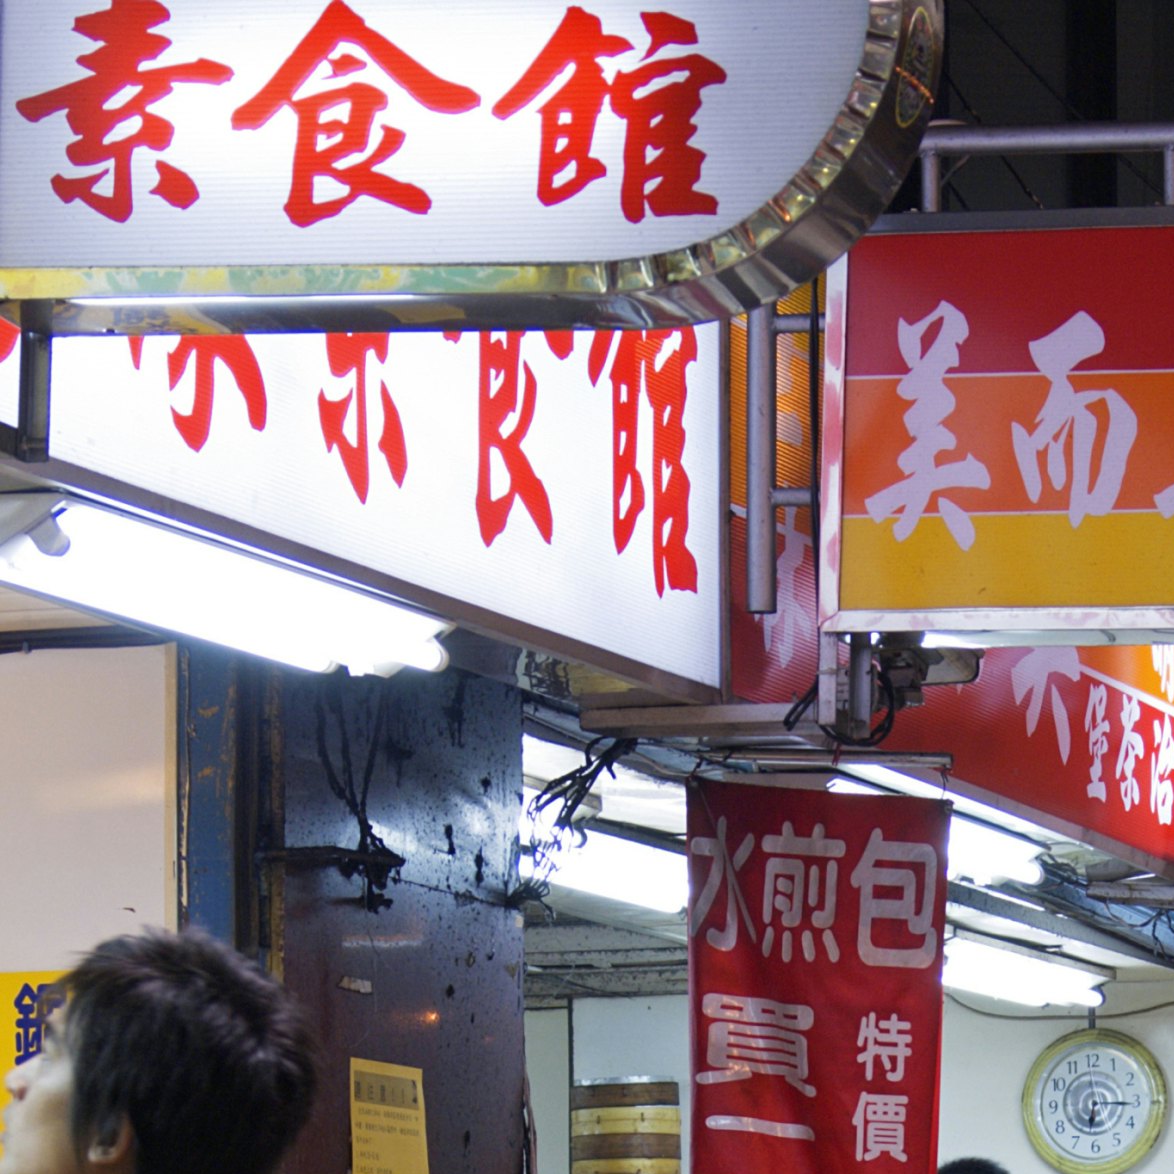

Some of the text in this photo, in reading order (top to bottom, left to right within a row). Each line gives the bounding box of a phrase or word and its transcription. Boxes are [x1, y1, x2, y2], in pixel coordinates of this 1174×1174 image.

[15, 0, 728, 228] 素食館
[689, 814, 939, 969] 水煎包
[1067, 1060, 1078, 1074] 11
[1086, 1053, 1099, 1068] 12
[1110, 1057, 1116, 1072] 1
[850, 1011, 913, 1163] 特價
[1052, 1077, 1066, 1092] 10
[1126, 1072, 1134, 1087] 2
[1049, 1100, 1058, 1114] 9
[1132, 1094, 1141, 1108] 3
[1055, 1120, 1065, 1134] 8
[1126, 1115, 1135, 1129] 4
[1071, 1135, 1080, 1149] 7
[1091, 1139, 1101, 1153] 6
[1112, 1132, 1121, 1147] 5
